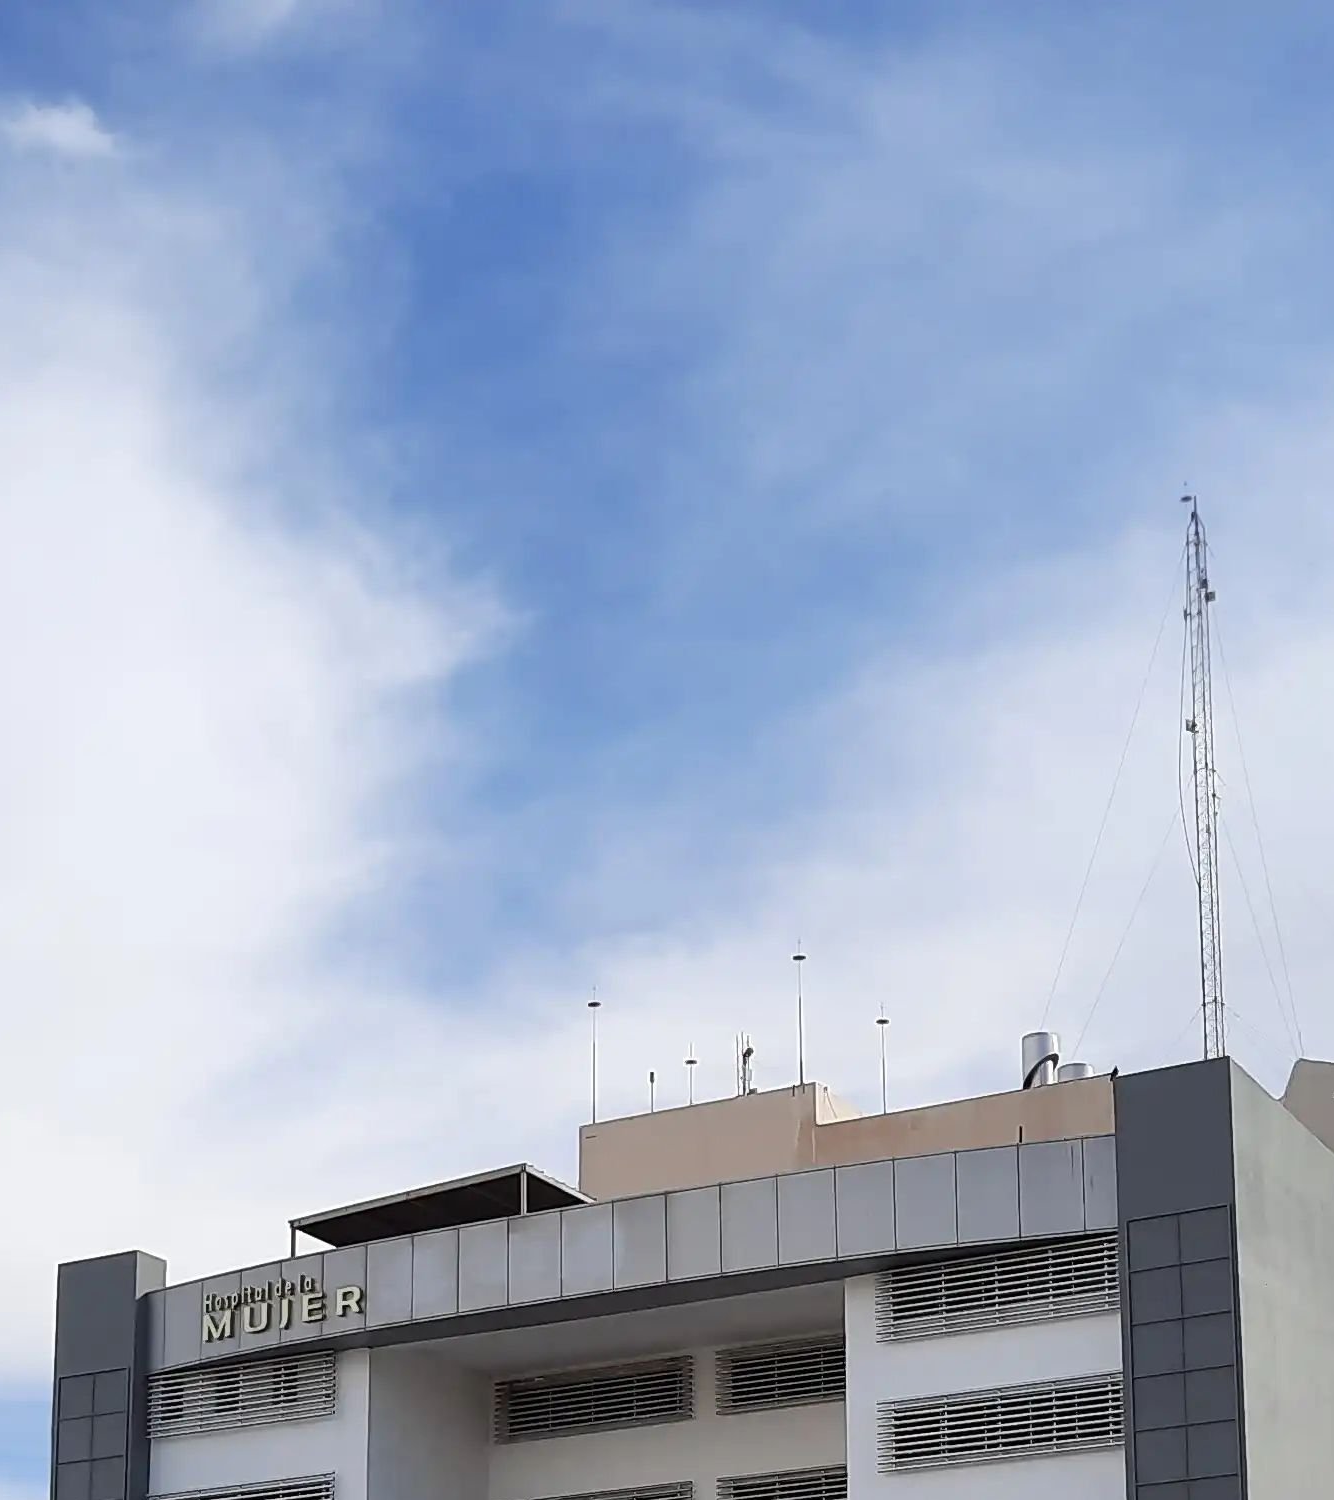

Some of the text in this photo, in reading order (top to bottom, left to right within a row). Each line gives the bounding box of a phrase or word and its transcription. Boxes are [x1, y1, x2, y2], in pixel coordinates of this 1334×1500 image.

[202, 1286, 362, 1343] MUJER
[204, 1274, 313, 1313] Hospital de la
